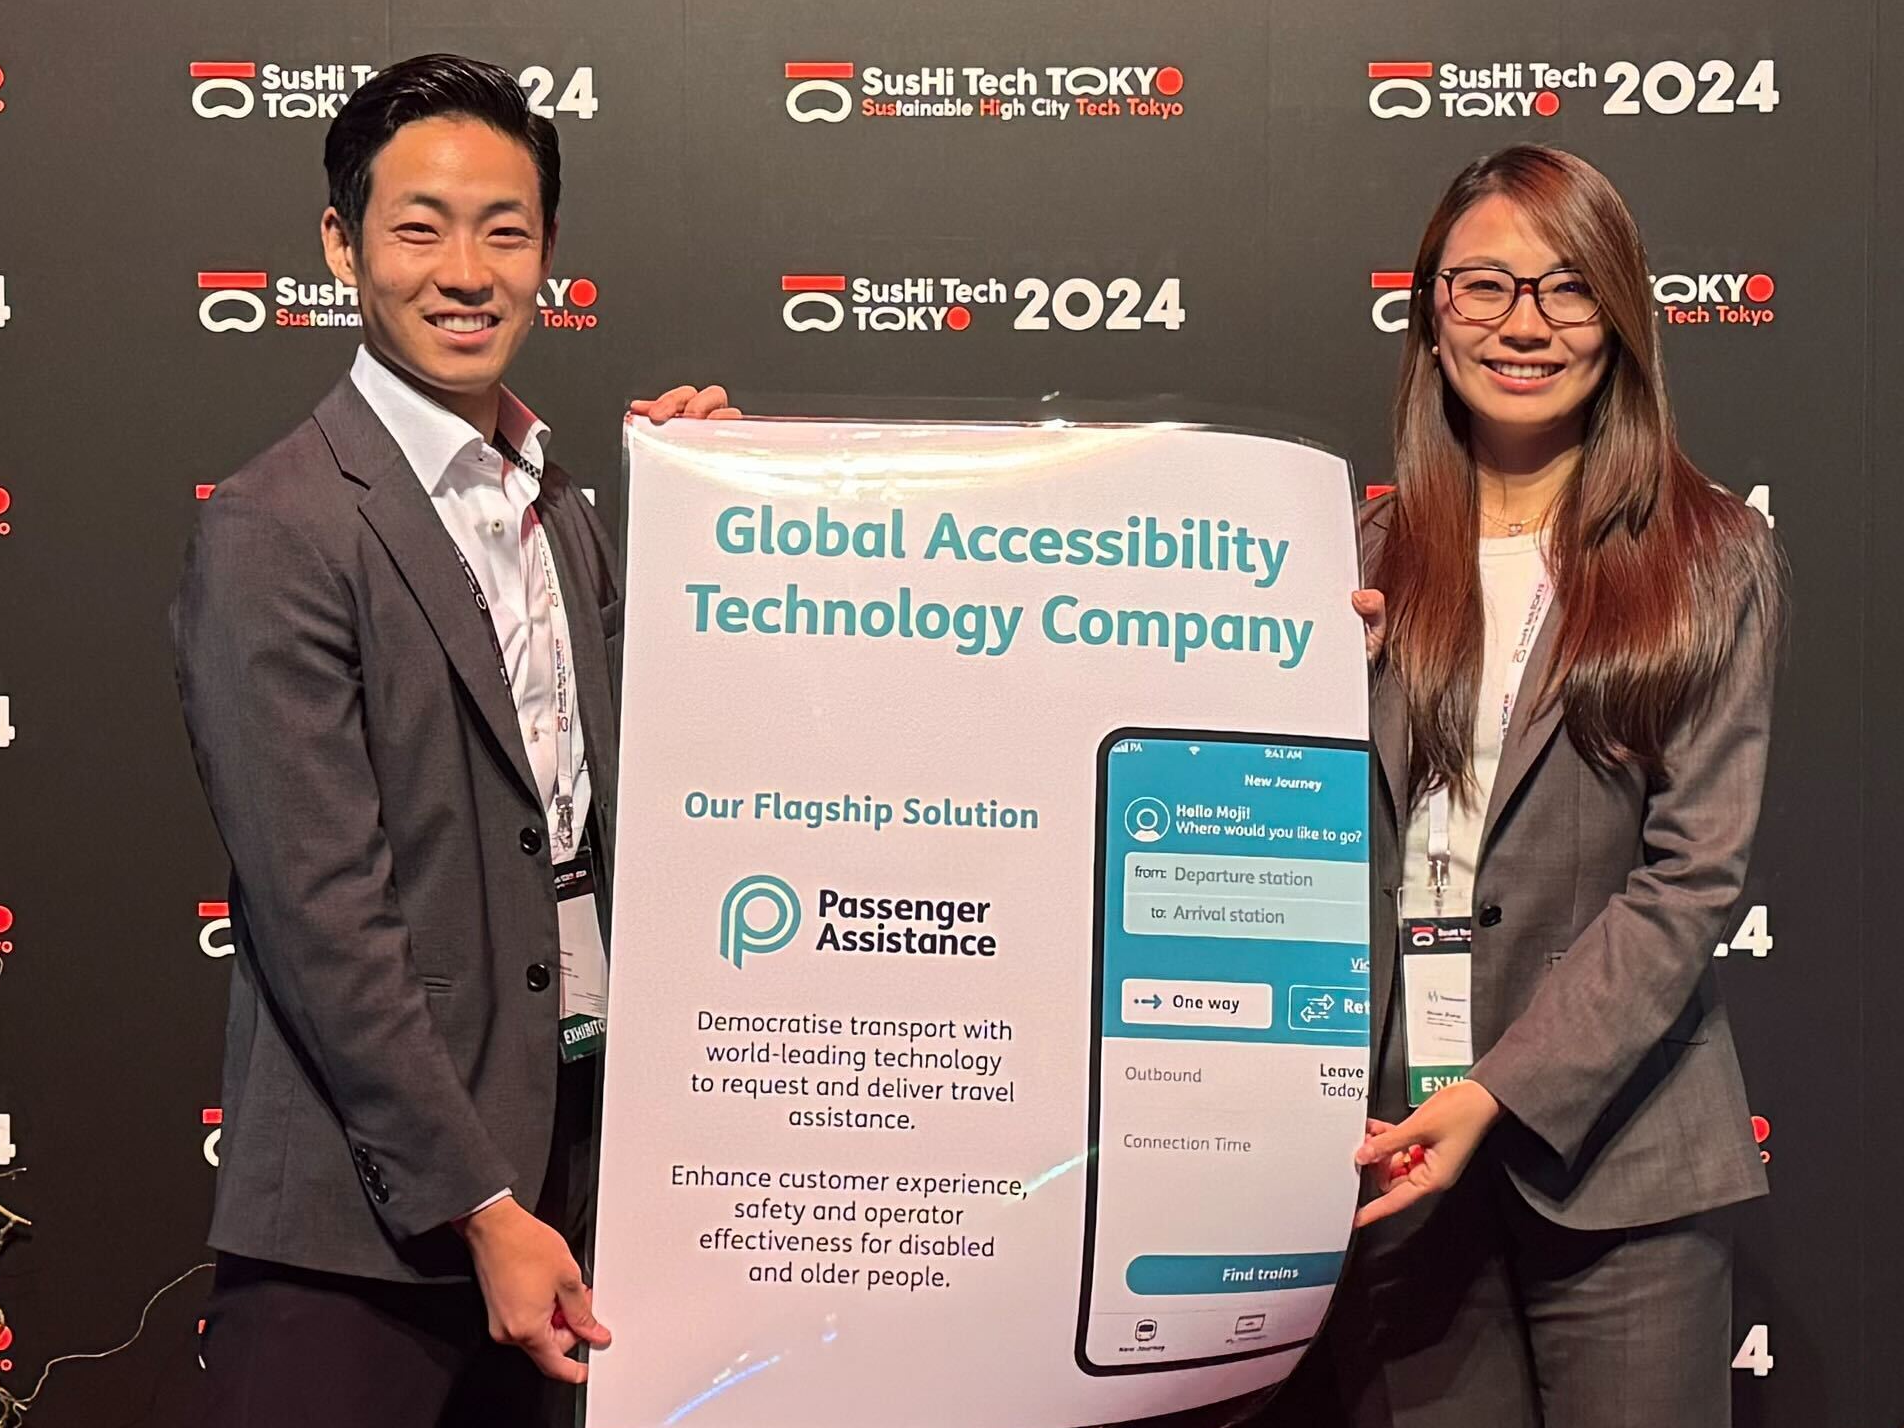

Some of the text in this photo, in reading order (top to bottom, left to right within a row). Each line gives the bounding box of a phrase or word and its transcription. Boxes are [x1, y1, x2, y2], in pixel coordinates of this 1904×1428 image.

[1440, 62, 1596, 89] SusHi Tech
[1604, 60, 1779, 114] 2024
[1440, 92, 1559, 117] TOKYO
[716, 506, 1289, 588] Global Accessibility
[685, 584, 1313, 668] Technology Company
[1286, 750, 1303, 760] AM
[1244, 774, 1323, 793] New Journey
[685, 791, 1039, 831] Our Flagship Solution
[1216, 805, 1251, 823] Moji!
[1176, 821, 1363, 845] Where would you like to go?
[1135, 866, 1313, 887] from: Departure station
[819, 889, 991, 930] Passenger
[1151, 905, 1285, 925] to: Arrival station
[816, 923, 996, 957] Assistance
[1172, 994, 1240, 1014] One way
[697, 1011, 1013, 1043] Democratise transport with
[706, 1042, 1002, 1076] world-leading technology
[1319, 1063, 1364, 1078] Leave
[1125, 1066, 1202, 1083] Outbound
[692, 1074, 1015, 1103] to request and deliver travel
[788, 1107, 916, 1130] assistance.
[1123, 1133, 1251, 1153] Connection Time
[671, 1165, 1028, 1200] Enhance customer experience,
[734, 1198, 964, 1228] safety and operator
[699, 1228, 995, 1257] effectiveness for disabled
[749, 1261, 951, 1292] and older people.
[1222, 1268, 1299, 1282] Find trains
